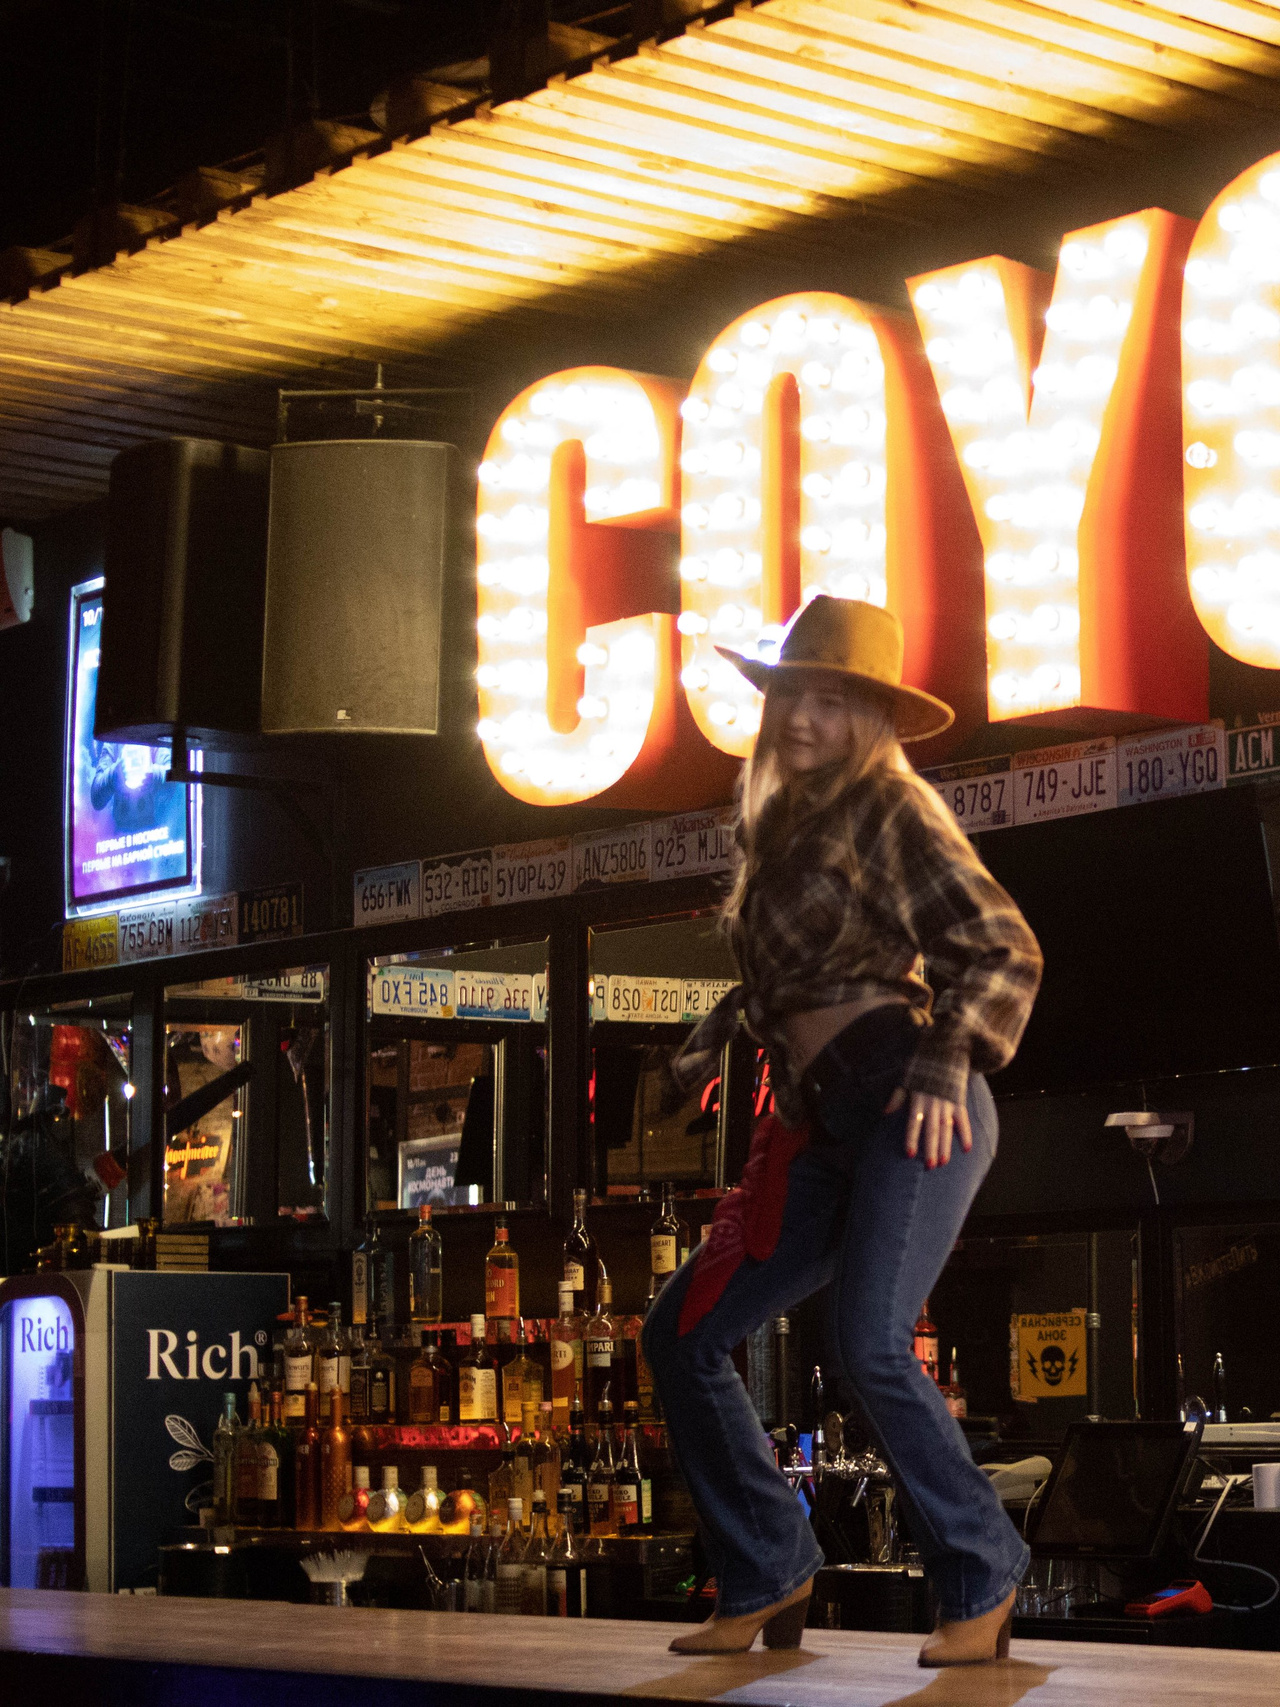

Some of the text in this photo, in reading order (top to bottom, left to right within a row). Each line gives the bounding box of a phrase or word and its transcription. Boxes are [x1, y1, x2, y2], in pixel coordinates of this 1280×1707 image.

[1234, 731, 1275, 773] ACM
[953, 779, 1006, 816] 8787
[655, 835, 686, 869] 925
[21, 1315, 69, 1353] Rich
